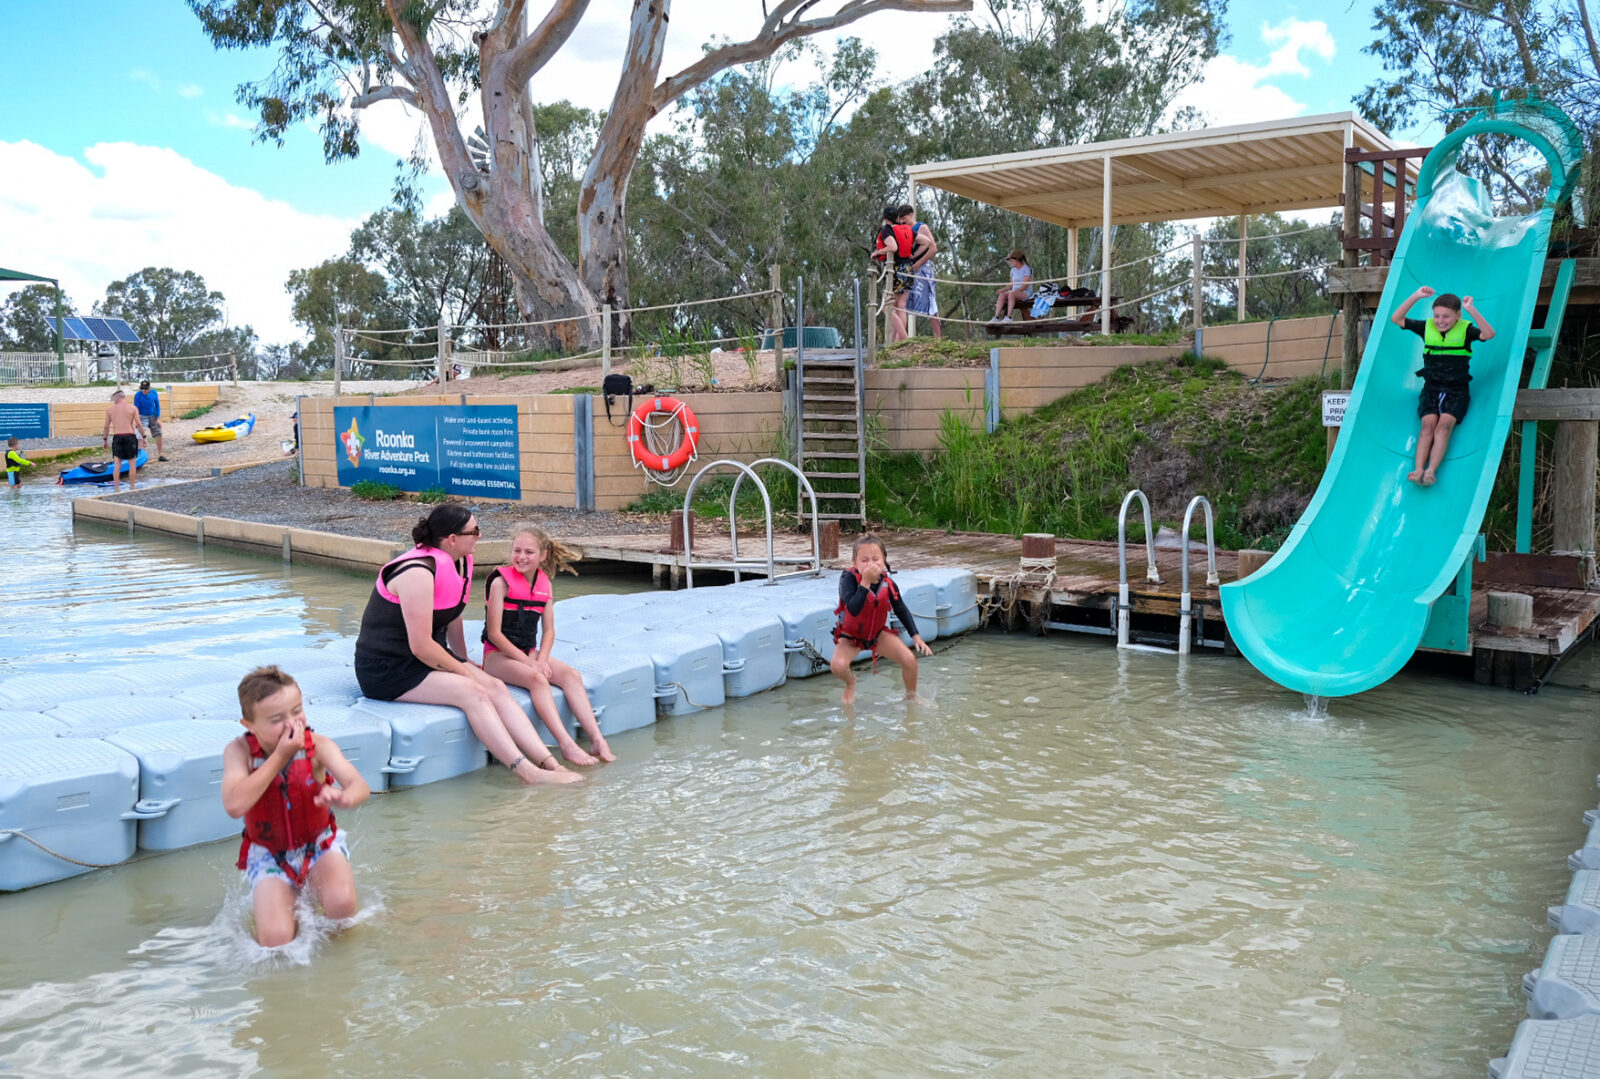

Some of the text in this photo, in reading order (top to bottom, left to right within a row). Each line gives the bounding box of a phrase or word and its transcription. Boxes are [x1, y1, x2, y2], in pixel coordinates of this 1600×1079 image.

[1327, 398, 1347, 406] KEEP
[1329, 407, 1347, 415] PRIV
[375, 429, 415, 449] Roonka
[364, 448, 430, 463] River Adventure Park
[379, 465, 416, 477] roonka.org.au
[451, 477, 516, 489] PRE-BOOKING ESSENTIAL
[256, 820, 274, 841] 2
